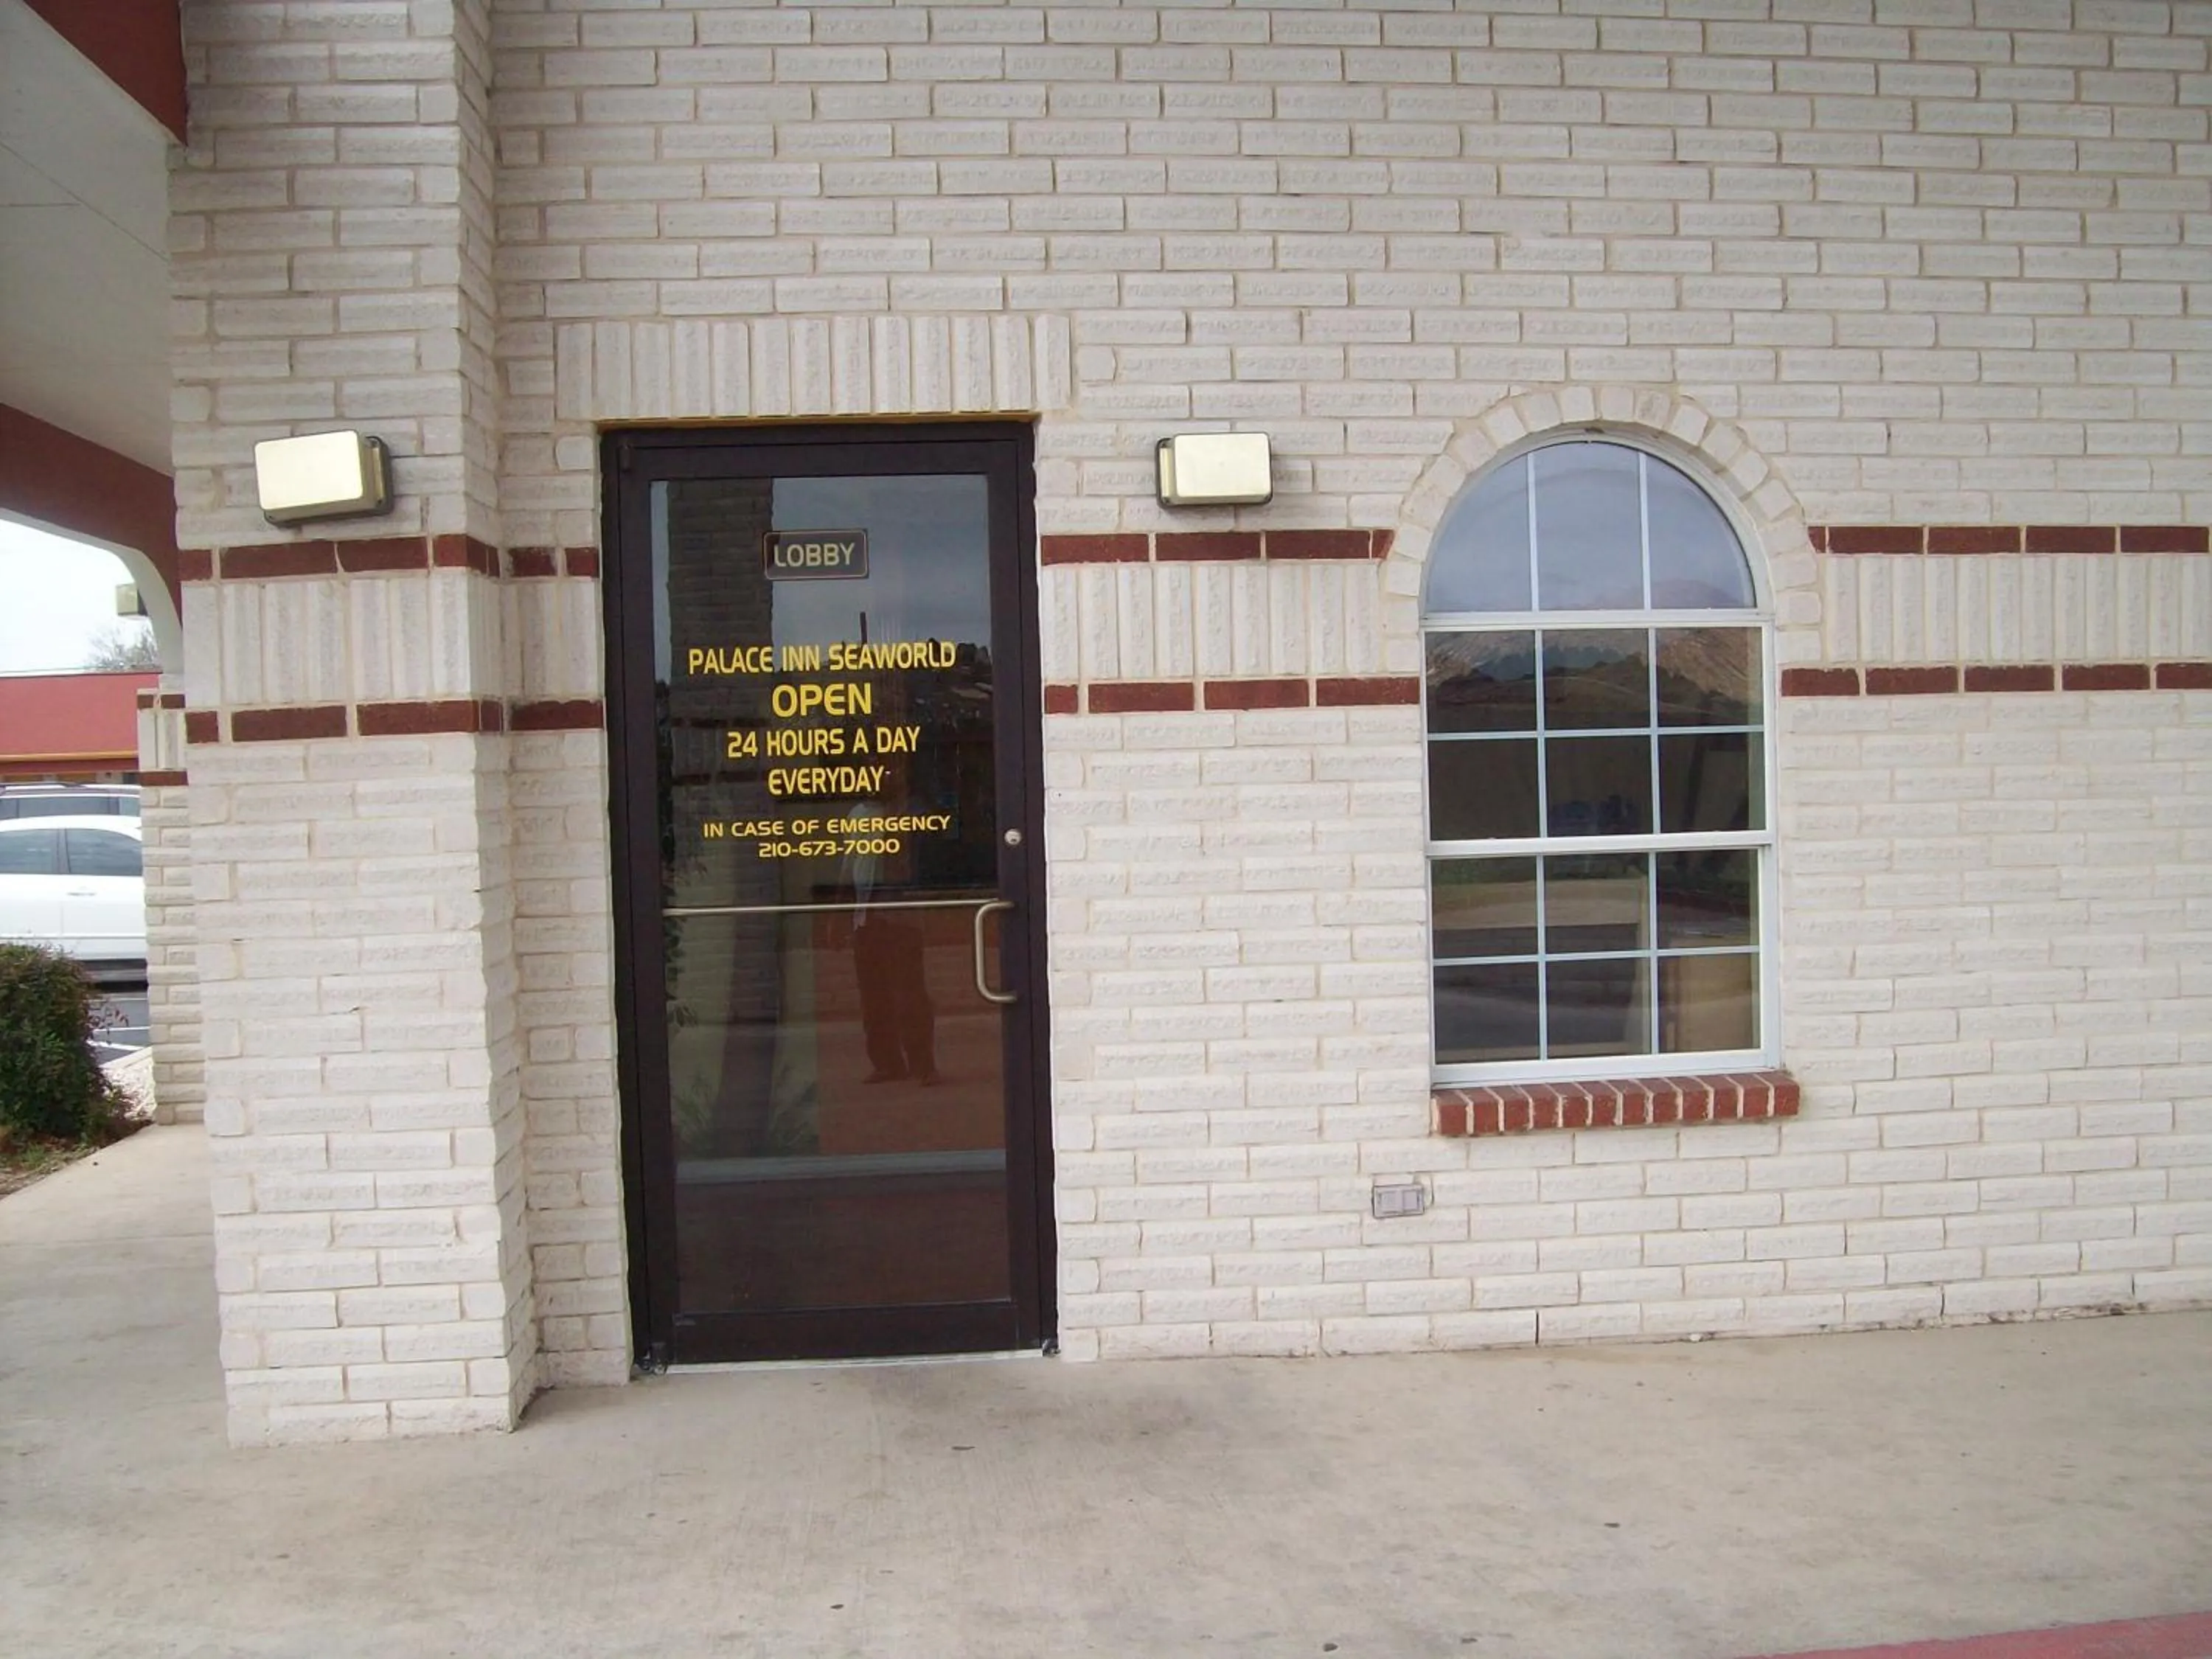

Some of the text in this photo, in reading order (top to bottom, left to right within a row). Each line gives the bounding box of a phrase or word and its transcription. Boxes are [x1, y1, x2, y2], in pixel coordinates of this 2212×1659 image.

[773, 543, 855, 567] LOBBY
[689, 641, 956, 675] PALACE INN SEAWORLD
[772, 683, 872, 717] OPEN
[727, 726, 920, 758] 24 HOURS A DAY
[768, 766, 884, 794] EVERYDAY
[704, 815, 950, 838] IN CASE OF EMERGENCY
[758, 838, 900, 857] 210-673-7000
